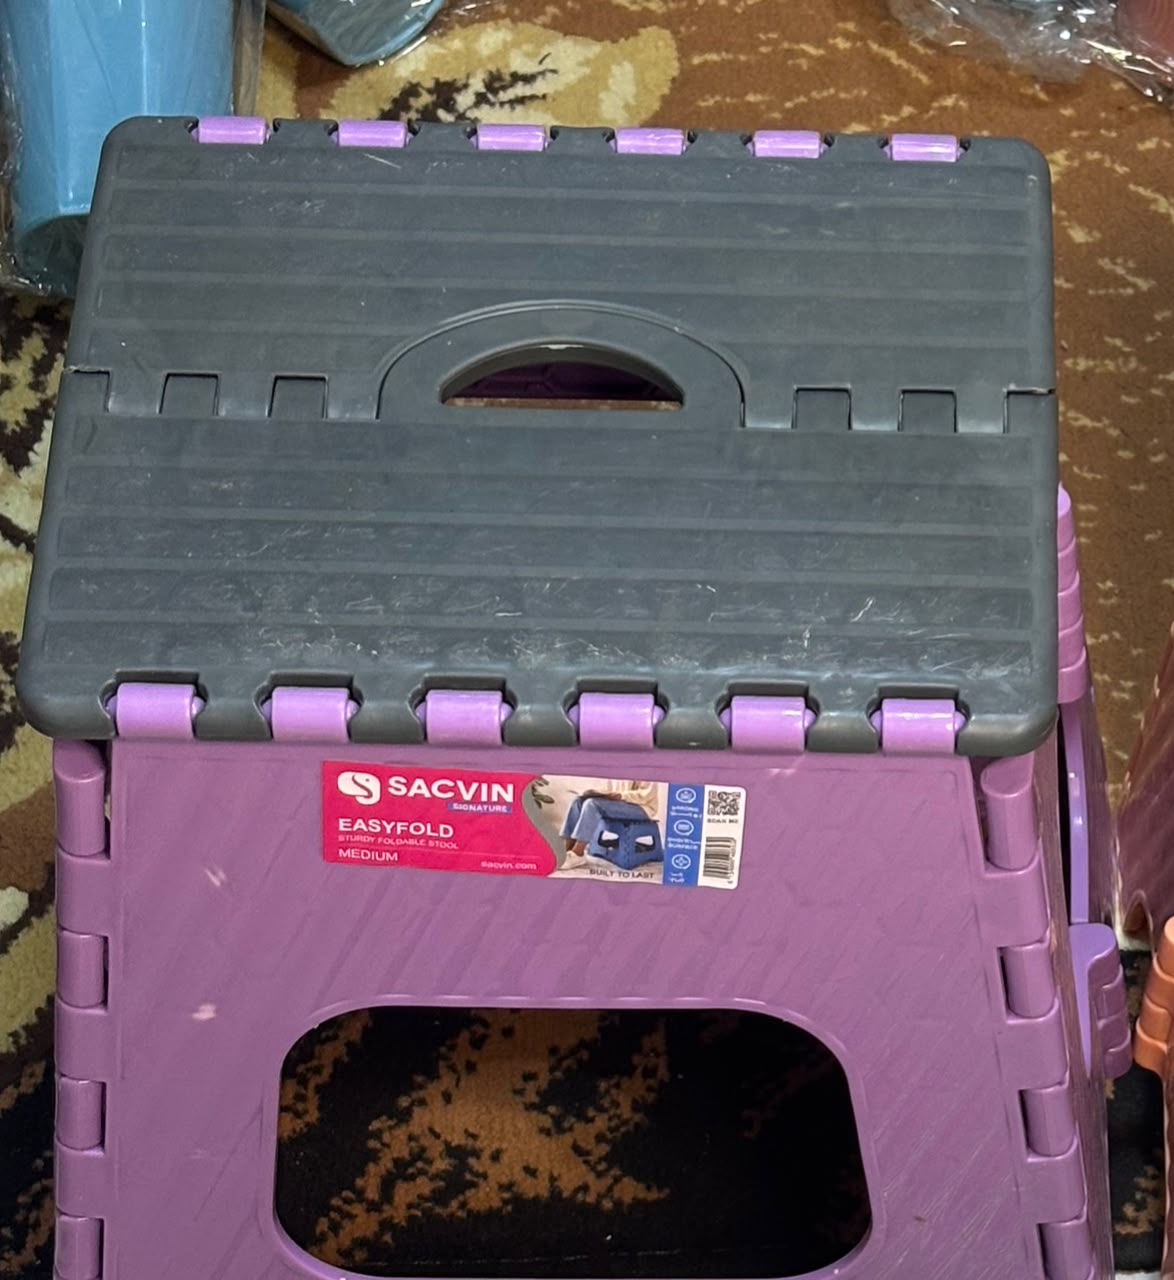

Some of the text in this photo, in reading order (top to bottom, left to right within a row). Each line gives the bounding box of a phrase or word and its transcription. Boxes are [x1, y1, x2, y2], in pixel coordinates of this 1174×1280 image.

[388, 775, 514, 803] SACVIN
[452, 803, 508, 813] SIGNATURE
[338, 817, 454, 838] EASYFOLD
[338, 835, 459, 850] STURDY FOLDABLE STOOL
[338, 848, 399, 861] MEDIUM
[480, 860, 537, 870] sacvin.com
[590, 869, 655, 879] BUILT TO LAST
